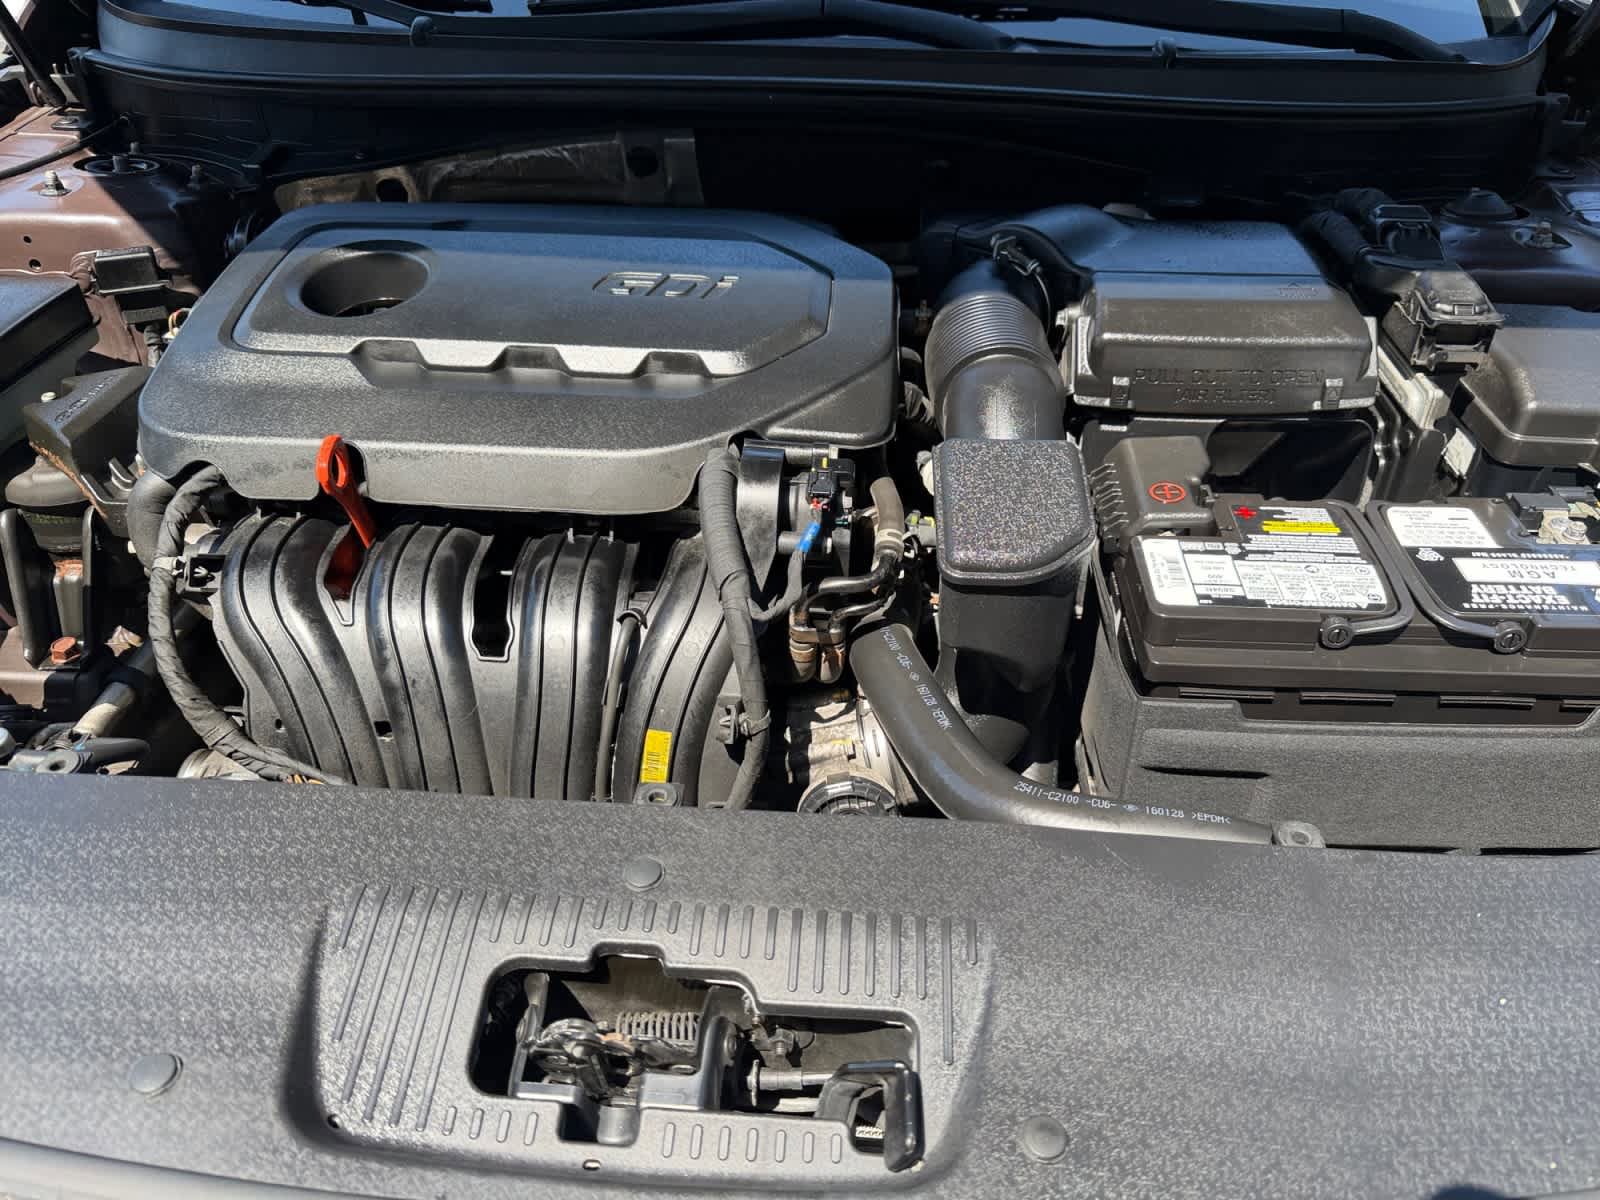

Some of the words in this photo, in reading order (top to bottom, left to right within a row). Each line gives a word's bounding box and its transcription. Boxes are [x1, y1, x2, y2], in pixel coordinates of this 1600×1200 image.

[1134, 368, 1185, 385] PULL
[1191, 368, 1232, 385] OUT
[1237, 368, 1265, 385] TO
[1271, 368, 1325, 385] OPEN
[1481, 562, 1576, 571] TECHNOLOGY
[1507, 570, 1556, 580] AGM
[1471, 584, 1557, 595] BATTERY
[1471, 593, 1570, 605] EXACT-FIT
[1013, 781, 1080, 804] 25411-C2100
